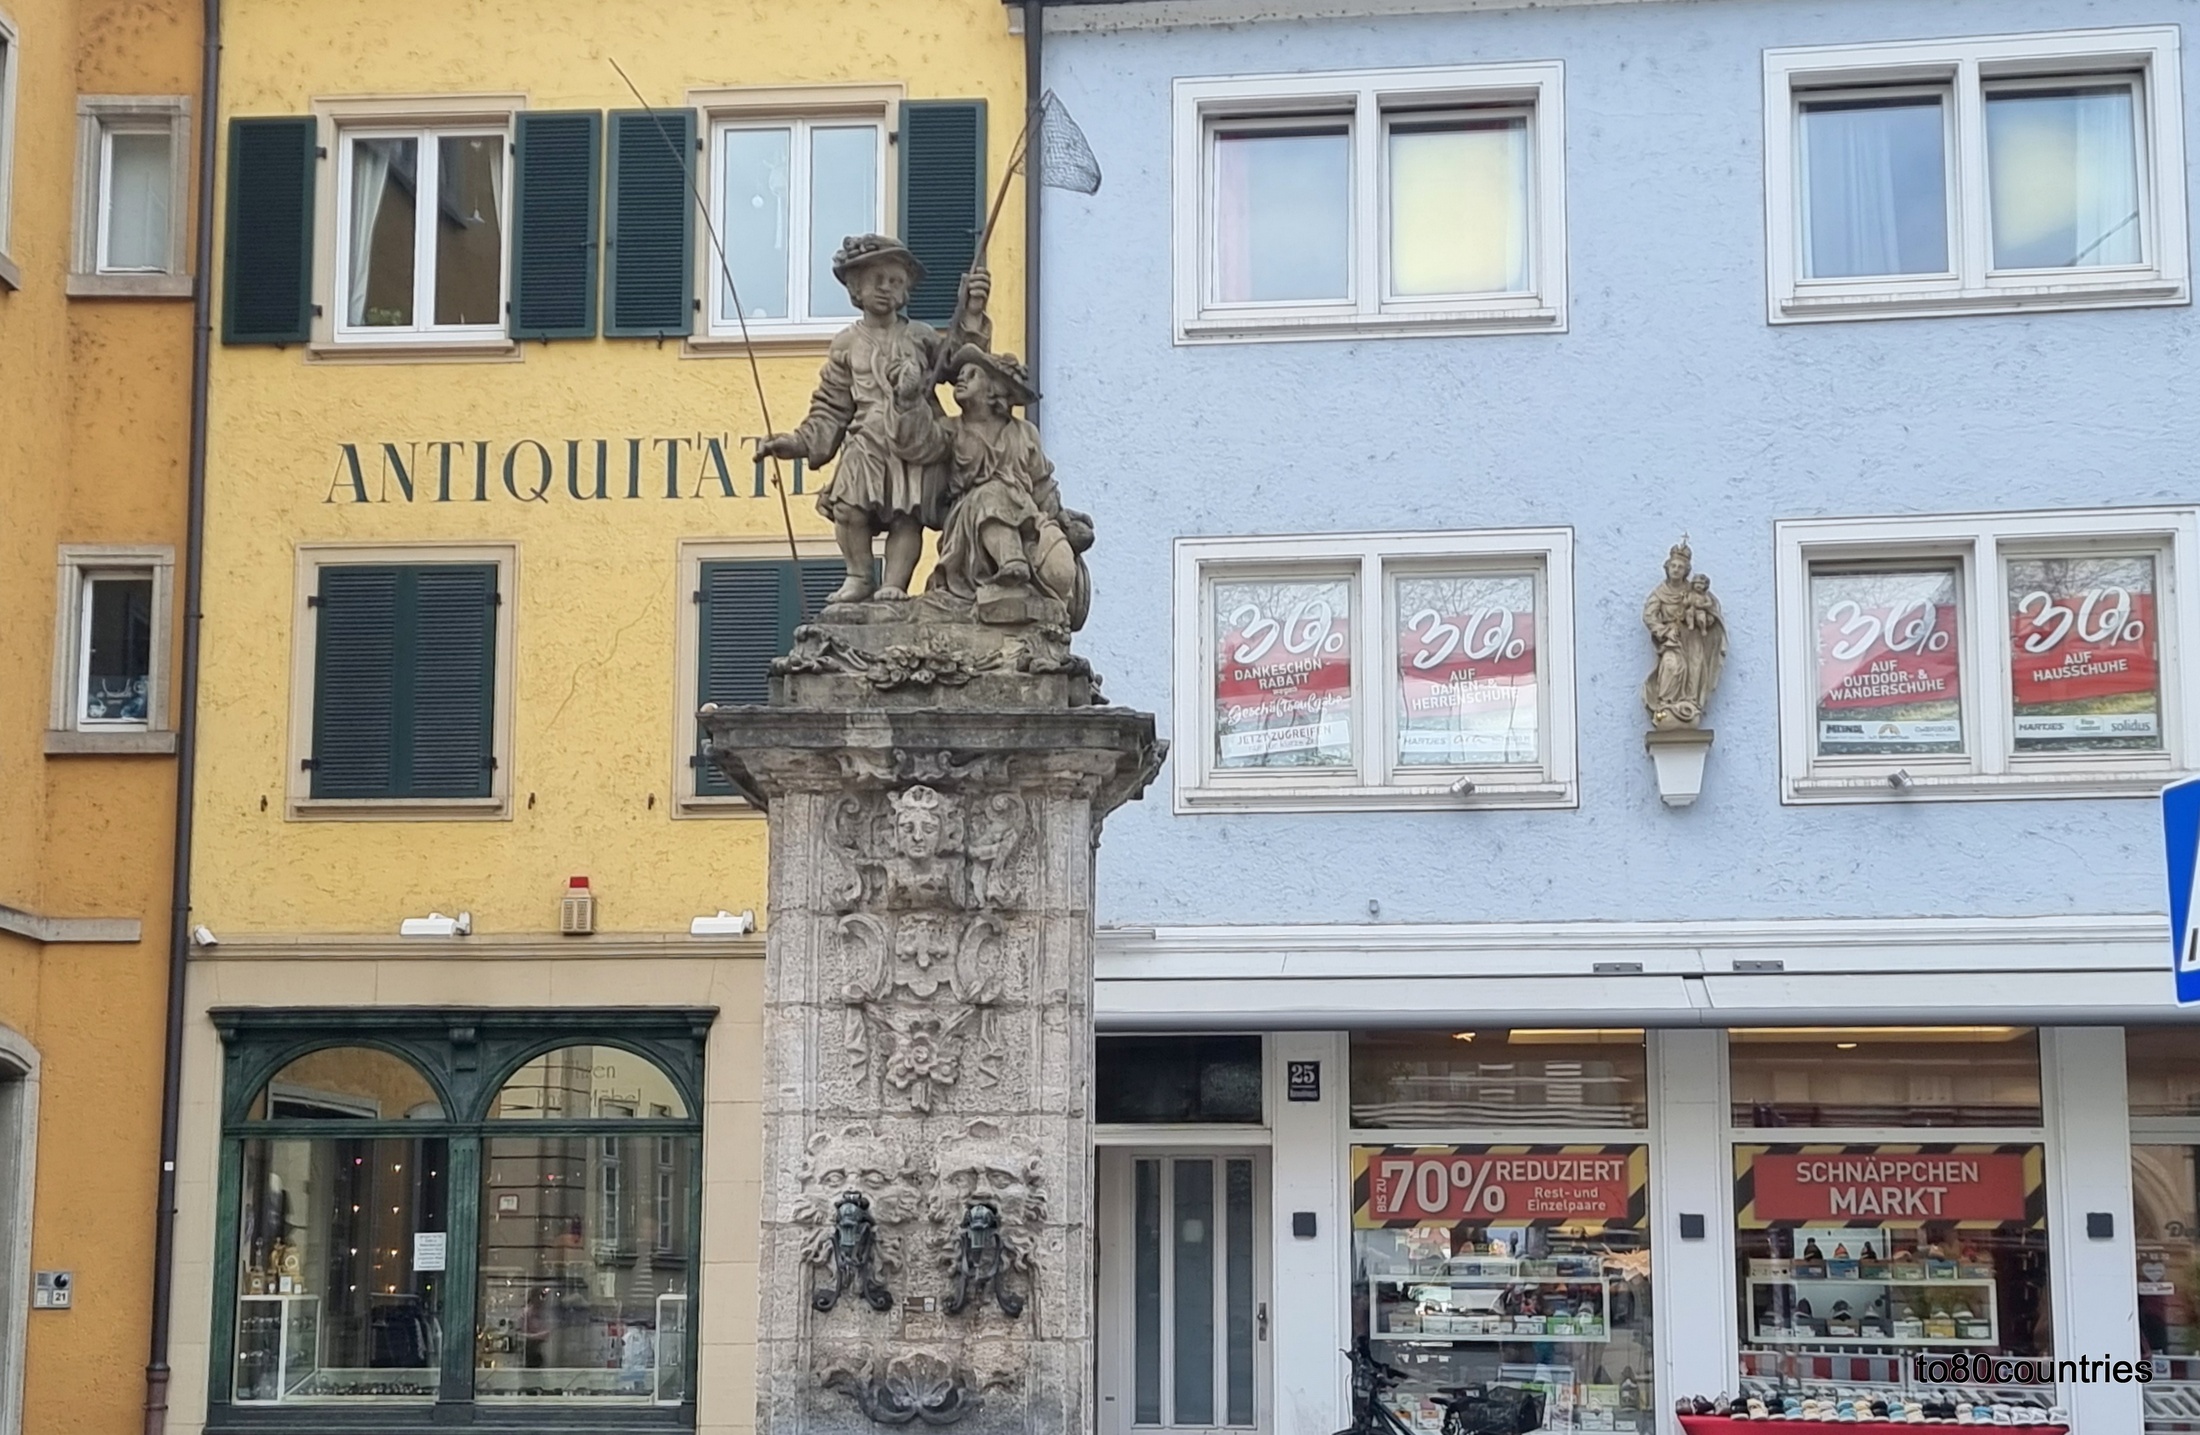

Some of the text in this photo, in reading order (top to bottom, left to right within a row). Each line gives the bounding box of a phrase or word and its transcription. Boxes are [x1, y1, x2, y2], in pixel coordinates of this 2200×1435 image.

[322, 432, 829, 504] ANTIQUITÄTE
[1827, 599, 1948, 660] 30%
[2018, 586, 2144, 653] 30%
[1229, 599, 1343, 664] 30%
[1408, 605, 1525, 669] 30%
[1870, 659, 1898, 674] AUF
[2064, 651, 2092, 666] AUF
[1258, 671, 1309, 690] RABATT
[1450, 668, 1476, 682] AUF
[1843, 669, 1928, 688] OUTDOOR- &
[2033, 659, 2128, 682] HAUSSCHUHE
[1411, 687, 1519, 711] HERRENSCHUHE
[1829, 678, 1945, 701] WANDERSCHUHE
[1271, 724, 1331, 741] ZUGREIFN
[2111, 719, 2151, 732] solidus
[1291, 1064, 1315, 1084] 25
[1796, 1156, 1979, 1183] SCHNÄPPCHEN
[1377, 1178, 1387, 1213] BIS ZU
[1382, 1160, 1624, 1214] 70% REDUZIERT
[1534, 1186, 1598, 1199] Rest- und
[1527, 1200, 1606, 1214] Einzelpaare
[1829, 1186, 1947, 1216] MARKT
[55, 1292, 66, 1302] 21
